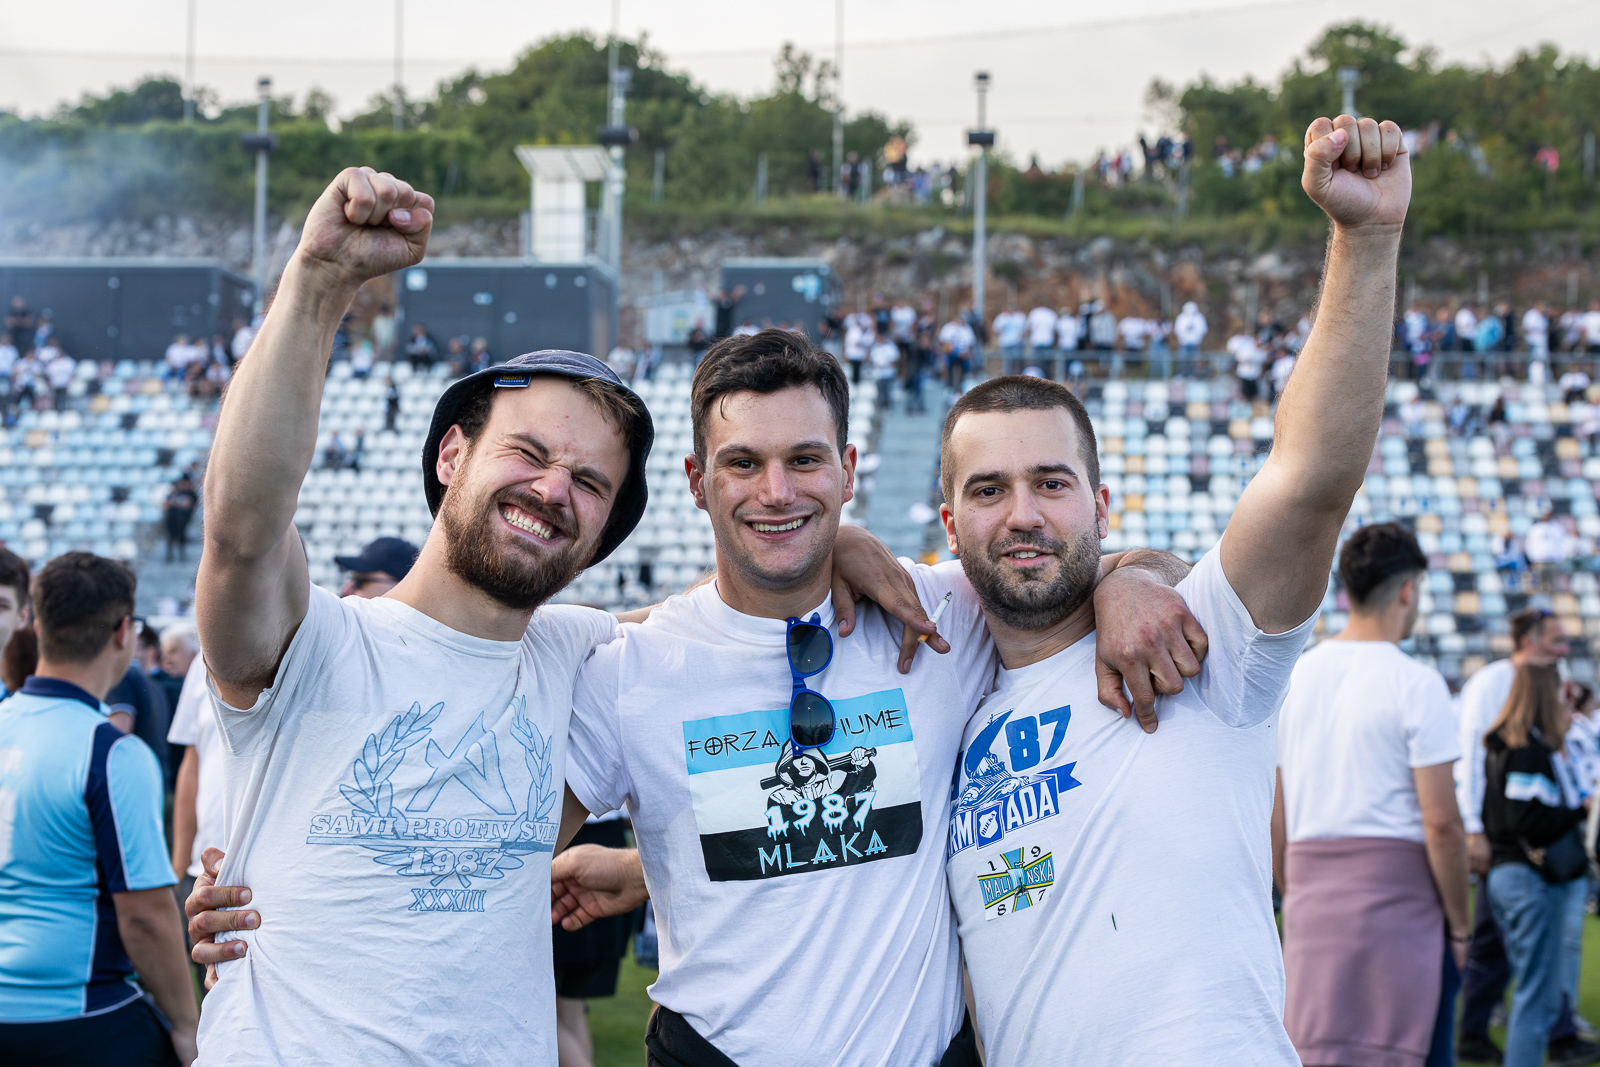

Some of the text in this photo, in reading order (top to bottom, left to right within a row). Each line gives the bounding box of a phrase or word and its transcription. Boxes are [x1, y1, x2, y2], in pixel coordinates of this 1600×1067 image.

[687, 708, 905, 760] FORZA IUME
[1005, 704, 1072, 773] 87
[309, 814, 398, 837] SAMI
[404, 817, 512, 840] PROTIV
[763, 789, 878, 842] 1987
[949, 811, 974, 857] RM
[406, 849, 505, 876] 1987
[757, 829, 889, 875] MLAKA
[408, 888, 488, 913] XXXIII
